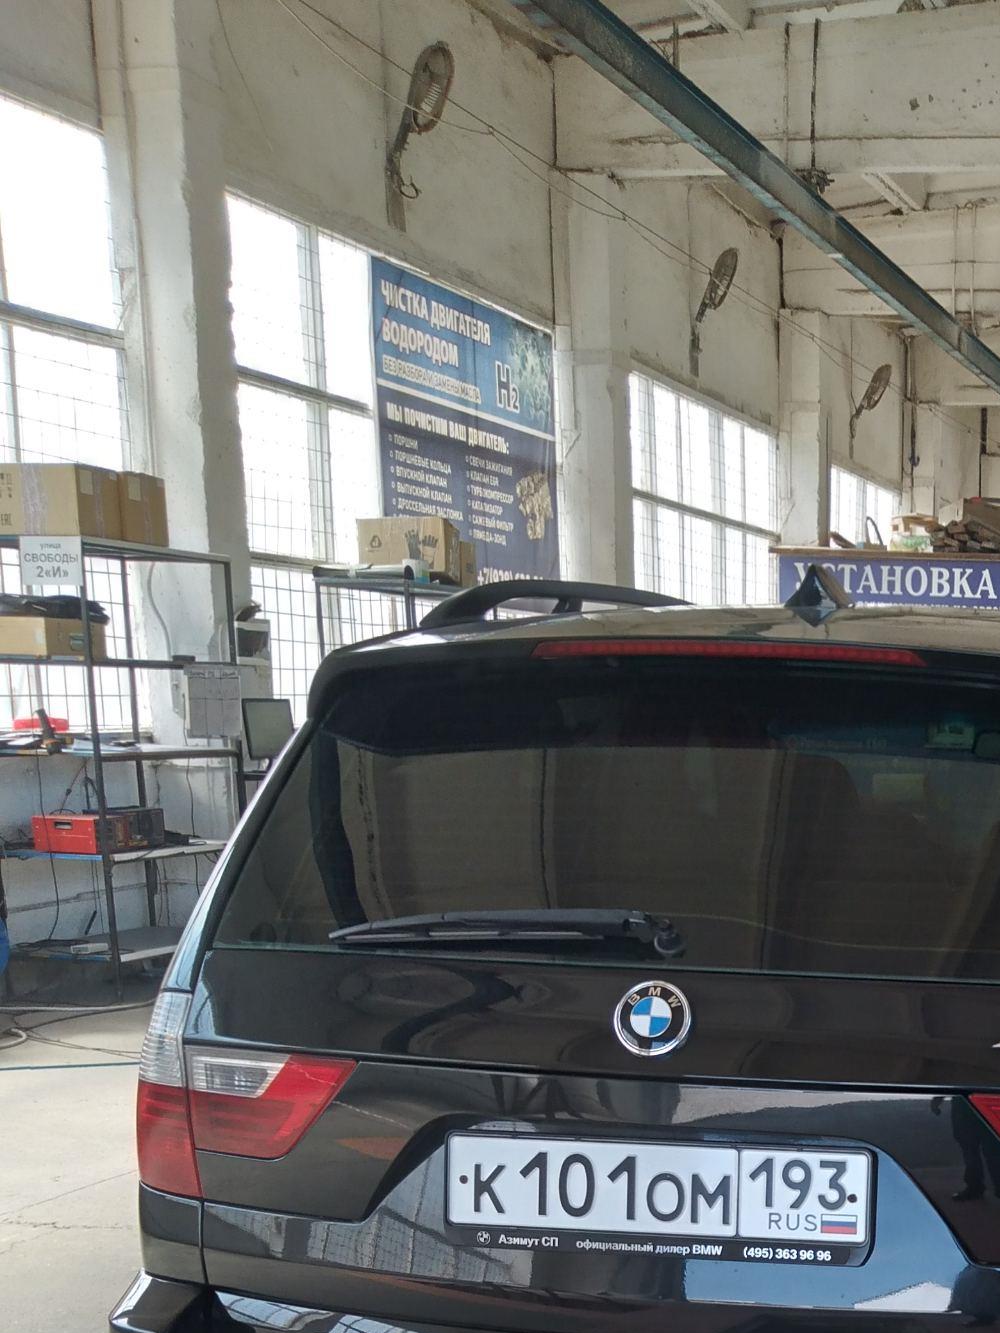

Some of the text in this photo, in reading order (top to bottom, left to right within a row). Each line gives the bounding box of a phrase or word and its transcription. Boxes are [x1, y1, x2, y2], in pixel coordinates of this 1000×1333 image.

[381, 279, 491, 346] ЧИСТКА ДВИГАТЕЛЯ
[382, 317, 459, 367] ВОДОРОДОМ
[386, 402, 509, 455] МЫ ПОЧИСТИМ ВАШ ДВИГАТЕЛЬ:
[394, 434, 418, 450] ПОРШНИ
[430, 460, 452, 475] КОЛЬЦА
[470, 456, 486, 469] СВЕЧИ
[396, 466, 448, 488] ВПУСКНОЙ КЛАПАН
[397, 481, 452, 504] ВЫПУСКНОЙ КЛАПАН
[398, 498, 464, 521] ДРОССЕЛЬНАЯ ЗАСЛОНКА
[24, 553, 78, 564] СВОБОДЫ
[36, 566, 69, 578] 2«И»
[628, 987, 682, 1008] BMW
[749, 1158, 848, 1210] 193
[768, 1212, 817, 1232] RUS
[498, 1234, 831, 1261] Азимут СП официальный дилер BMW (495) 363 96 96
